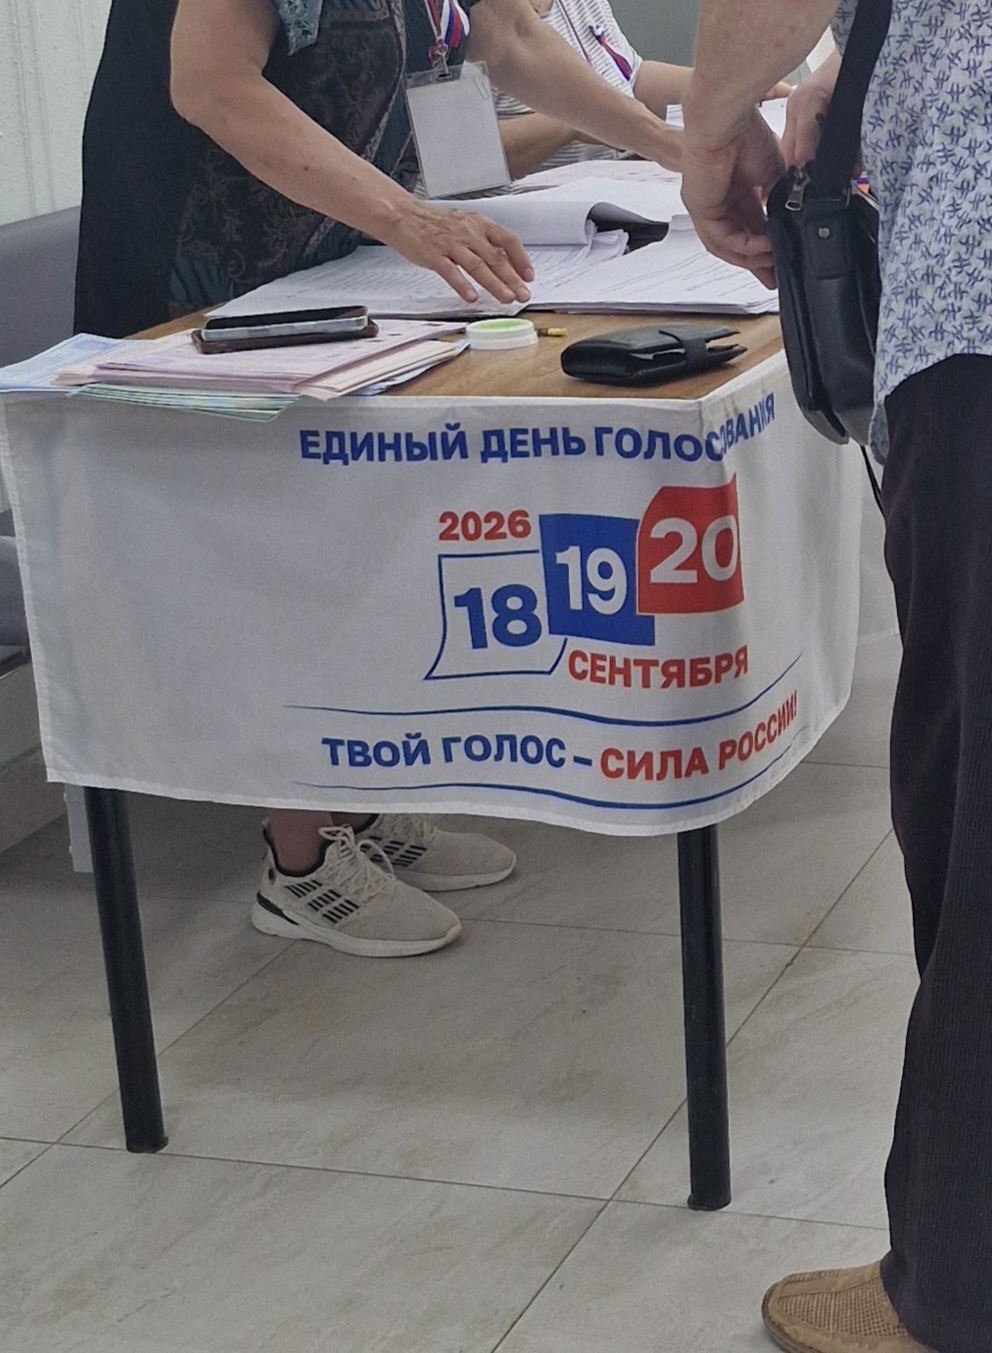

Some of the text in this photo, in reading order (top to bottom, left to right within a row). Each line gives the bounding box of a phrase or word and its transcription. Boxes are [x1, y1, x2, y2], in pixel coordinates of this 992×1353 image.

[299, 392, 775, 466] ЕДИНЫЙ ДЕНЬ ГОЛОСОВАНИЯ
[438, 509, 532, 542] 2026
[454, 514, 739, 650] 18 19 20
[568, 644, 748, 689] СЕНТЯБРЯ
[321, 733, 430, 768] ТВОЙ
[441, 734, 566, 768] ГОЛОС
[600, 746, 709, 781] СИЛА
[718, 689, 799, 771] РОССИИ!
